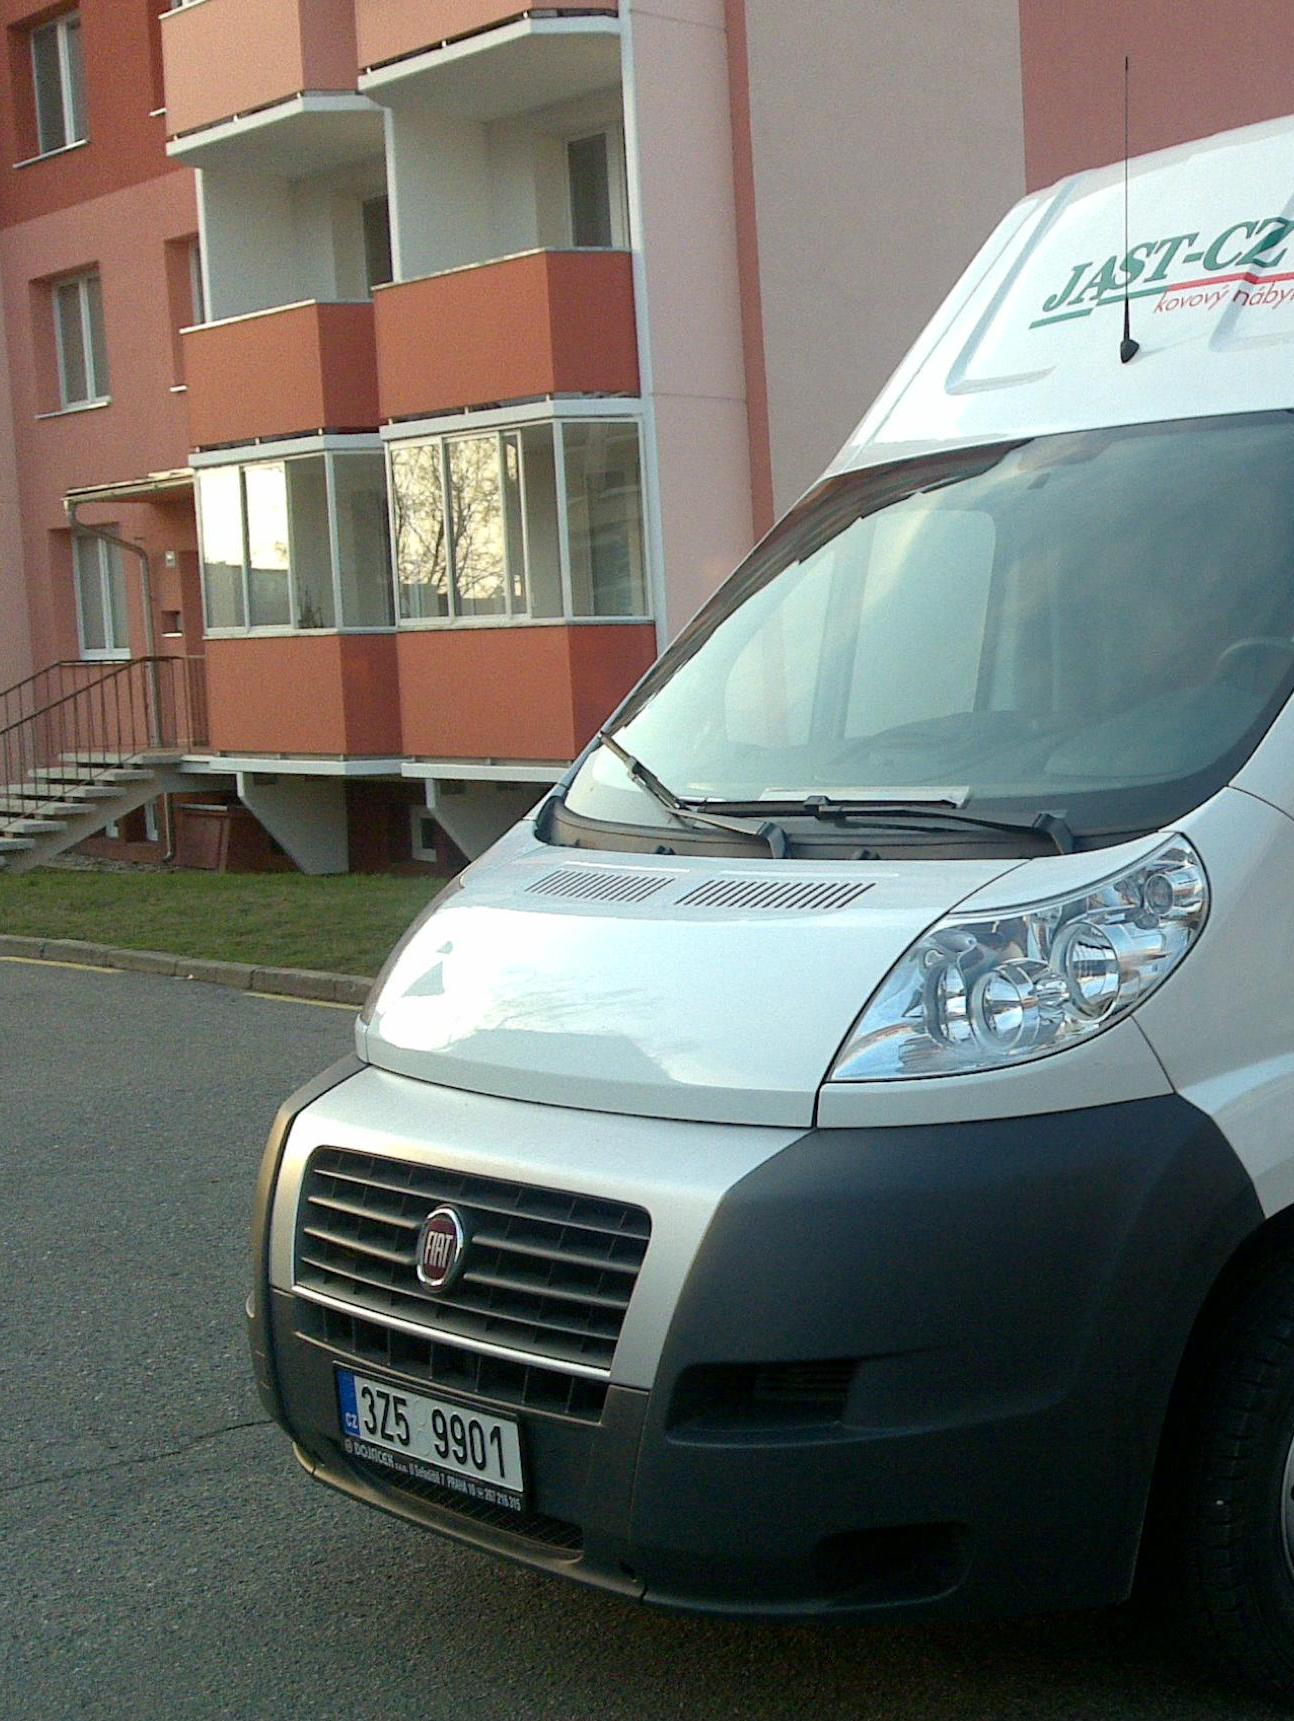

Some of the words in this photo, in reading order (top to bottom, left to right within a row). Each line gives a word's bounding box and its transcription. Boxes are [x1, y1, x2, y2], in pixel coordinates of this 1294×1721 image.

[1153, 287, 1228, 314] kovový
[424, 1230, 453, 1268] FIAT
[345, 1411, 358, 1429] CZ
[361, 1386, 410, 1446] 3Z5
[432, 1408, 505, 1478] 9901
